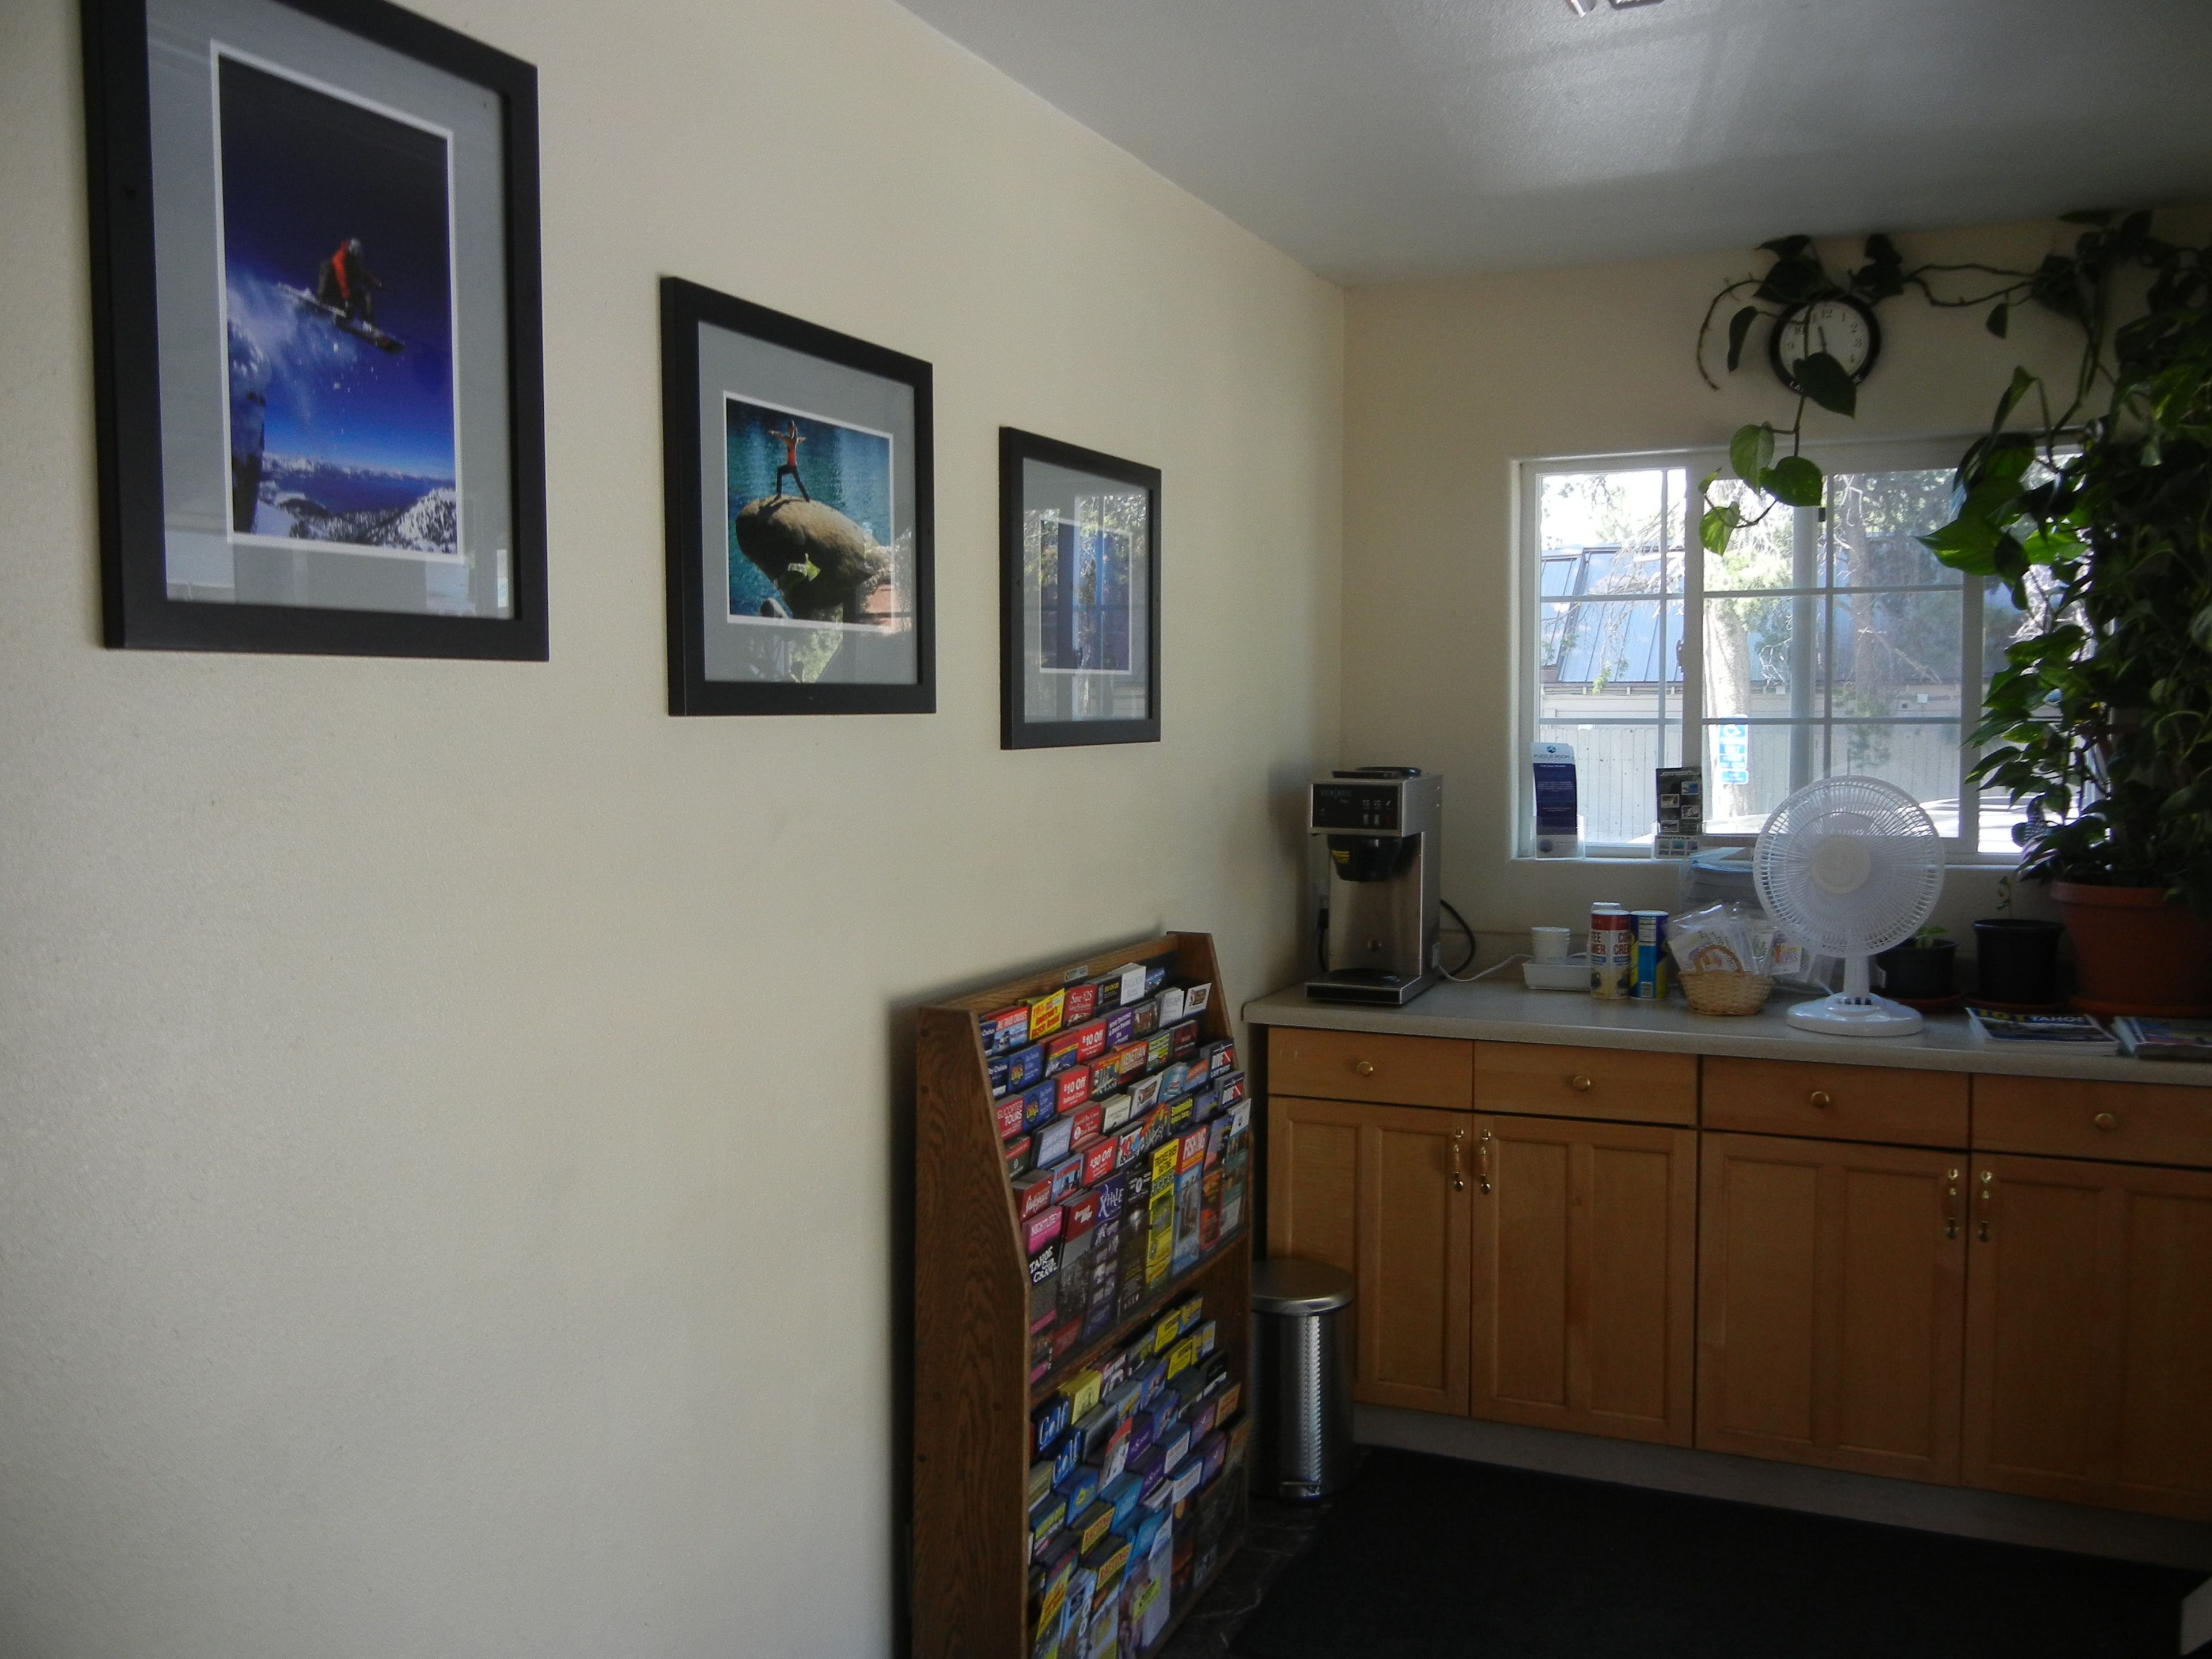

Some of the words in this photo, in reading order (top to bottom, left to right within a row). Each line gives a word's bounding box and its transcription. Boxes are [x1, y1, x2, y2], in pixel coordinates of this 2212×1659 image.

[1821, 309, 1833, 318] 12
[1850, 324, 1857, 332] 2
[1788, 342, 1794, 350] 9
[1855, 339, 1862, 347] 3
[1082, 1035, 1093, 1046] $10
[1093, 1029, 1104, 1043] Off
[1063, 1081, 1075, 1094] $10
[1075, 1075, 1086, 1090] Off
[1004, 1111, 1022, 1126] TOURS
[1101, 1146, 1113, 1162] Off
